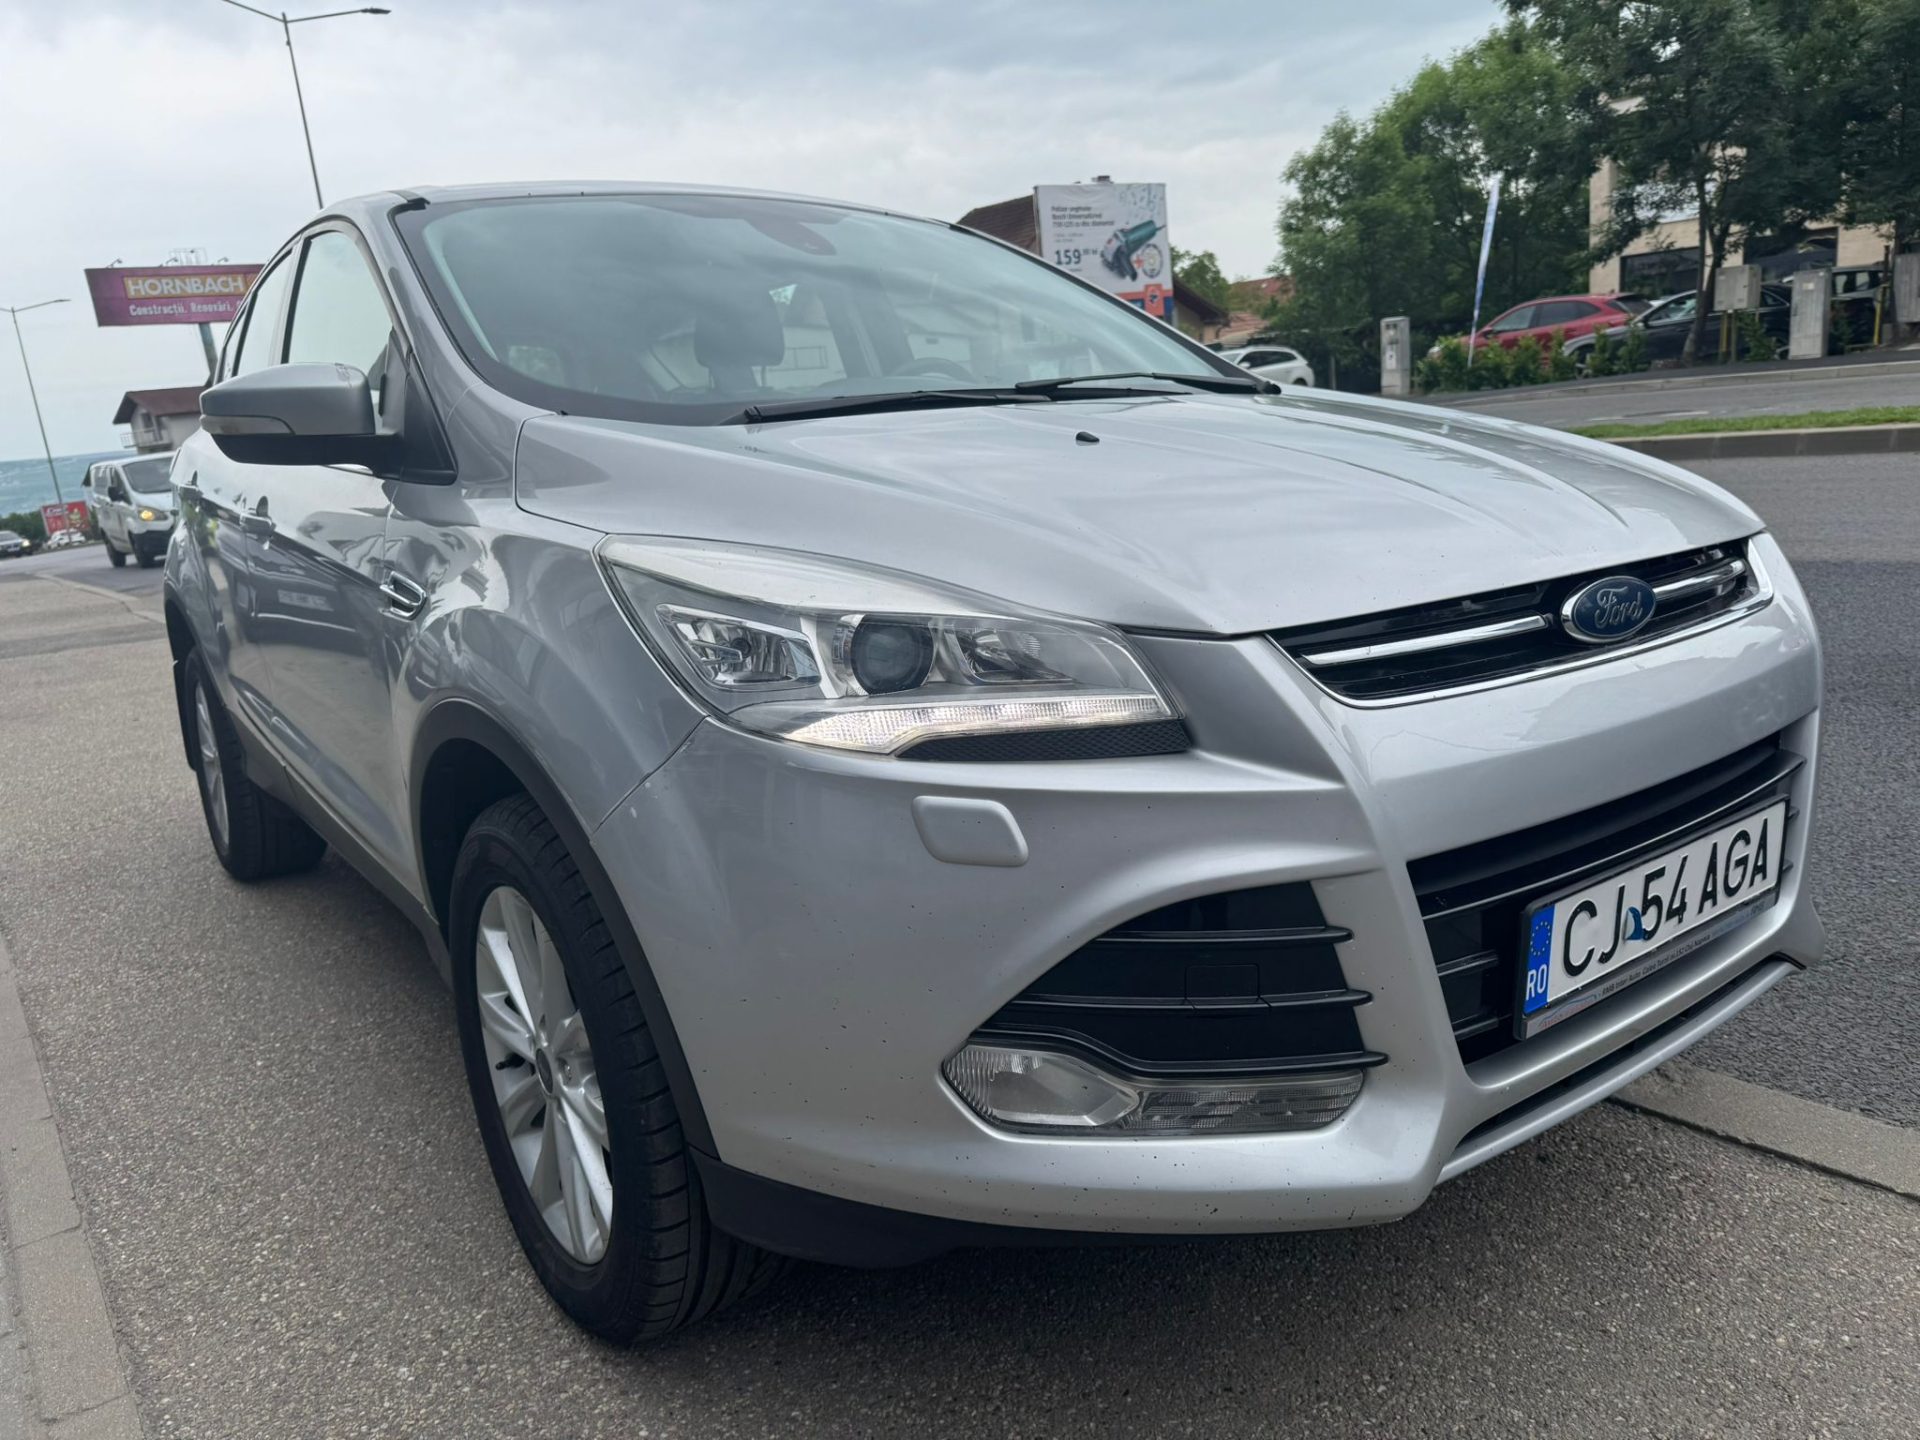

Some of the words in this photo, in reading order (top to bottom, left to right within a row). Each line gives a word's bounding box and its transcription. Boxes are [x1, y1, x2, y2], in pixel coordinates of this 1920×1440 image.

[1054, 248, 1082, 265] 159
[128, 276, 245, 297] HORNBACH
[1594, 585, 1644, 629] Ford
[1563, 885, 1625, 977] CJ
[1641, 854, 1688, 941] 54
[1697, 817, 1769, 915] AGA
[1525, 963, 1548, 1001] RO
